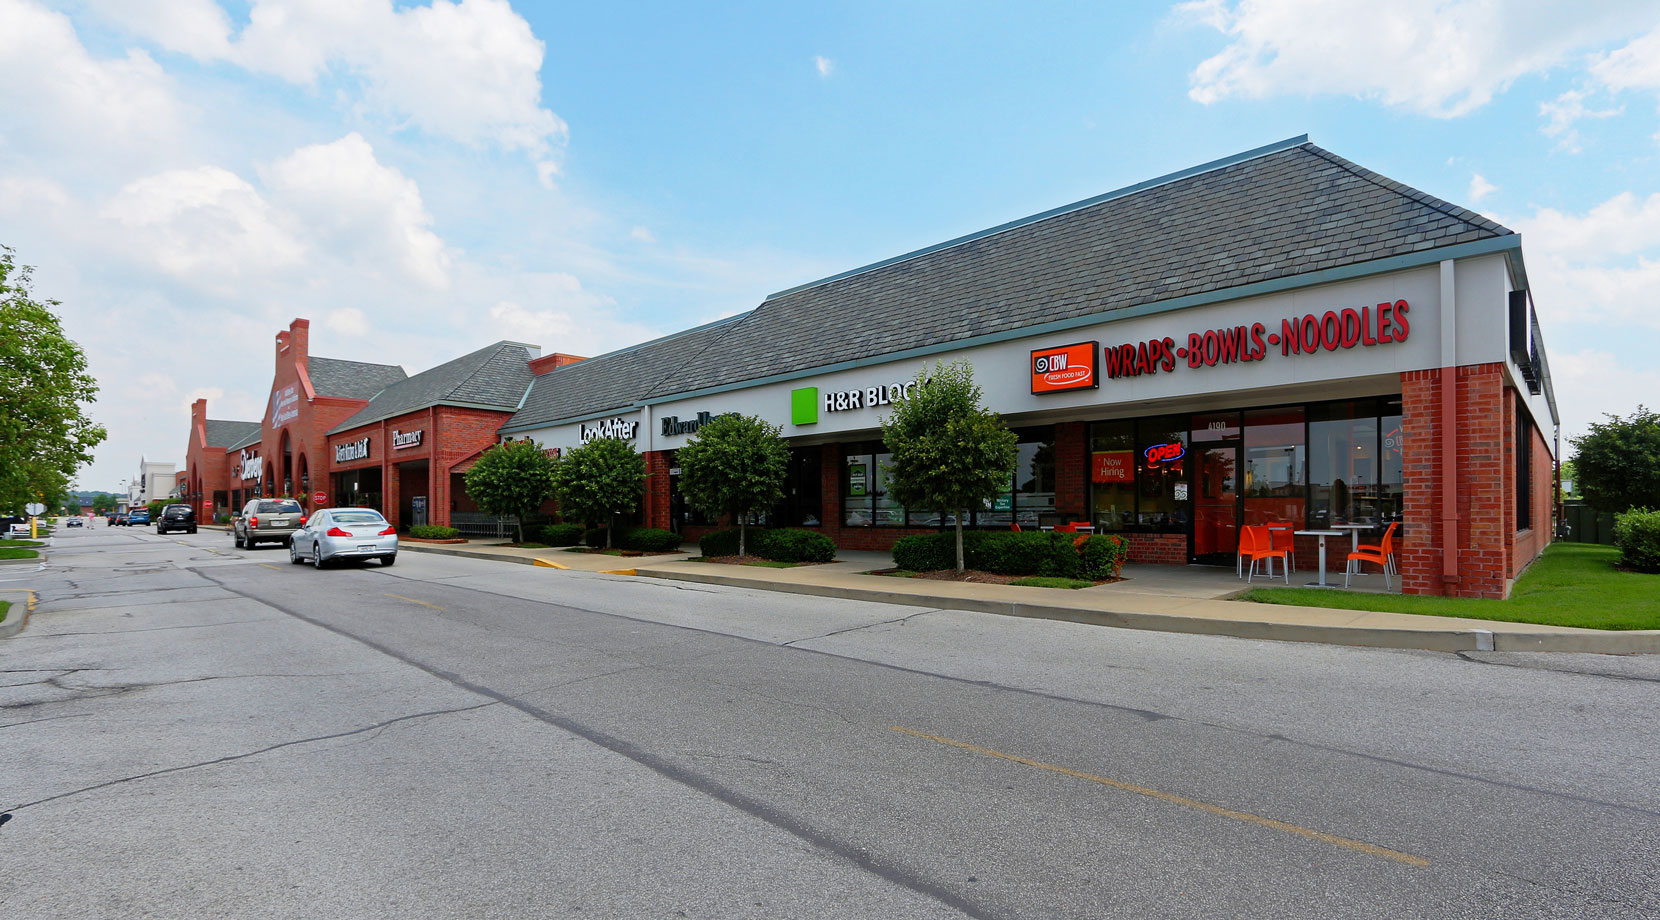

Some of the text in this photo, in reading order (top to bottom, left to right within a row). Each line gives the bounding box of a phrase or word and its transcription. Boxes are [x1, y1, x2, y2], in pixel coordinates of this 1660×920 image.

[1104, 299, 1410, 379] WRAPS BOWLS NOODLES
[1049, 353, 1068, 372] CBW
[824, 378, 932, 412] H&R BLOC
[1208, 421, 1226, 431] 4190
[392, 430, 422, 446] Pharmacy
[1148, 442, 1182, 462] OPEN
[1103, 457, 1122, 466] Now
[1101, 467, 1125, 478] Hiring
